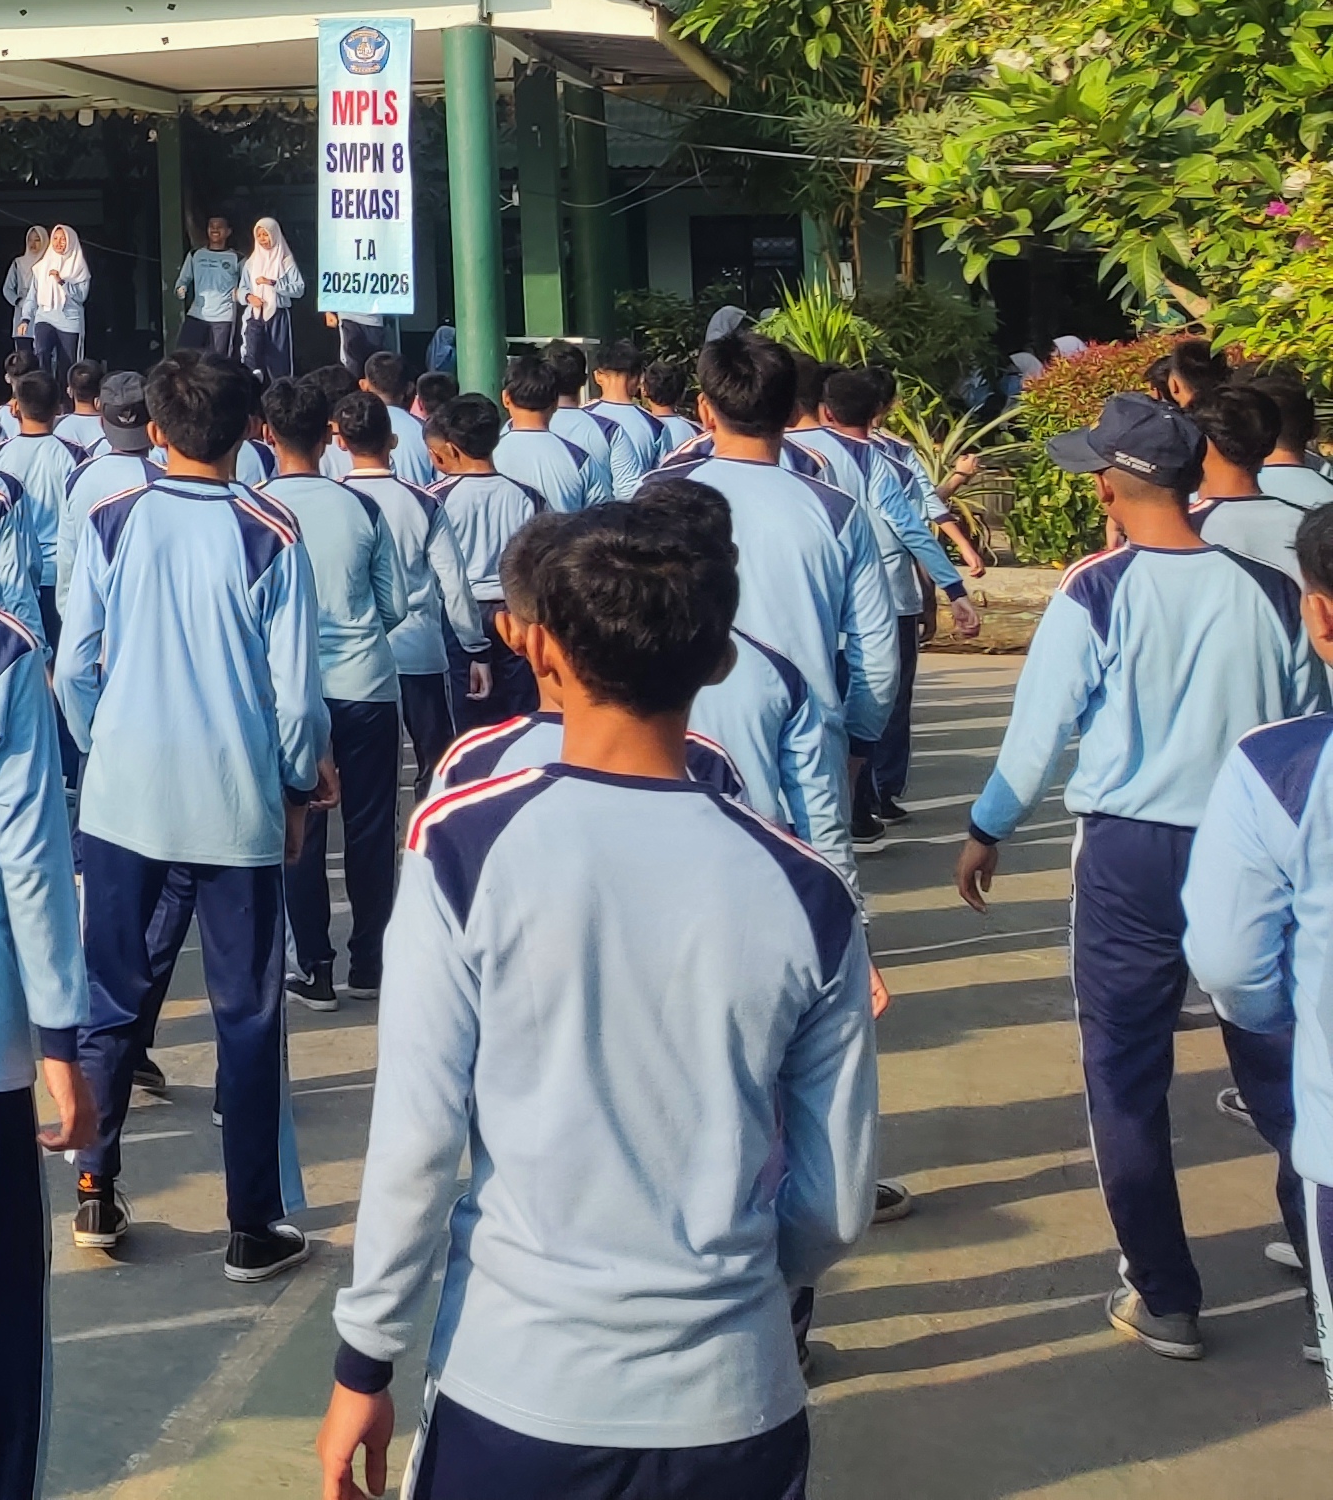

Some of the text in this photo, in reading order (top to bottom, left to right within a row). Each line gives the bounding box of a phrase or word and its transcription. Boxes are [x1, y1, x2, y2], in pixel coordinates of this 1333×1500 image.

[332, 89, 398, 126] MPLS
[325, 142, 404, 173] SMPN 8
[331, 189, 400, 220] BEKASI
[354, 238, 376, 261] T.A
[322, 272, 410, 296] 2025/2026
